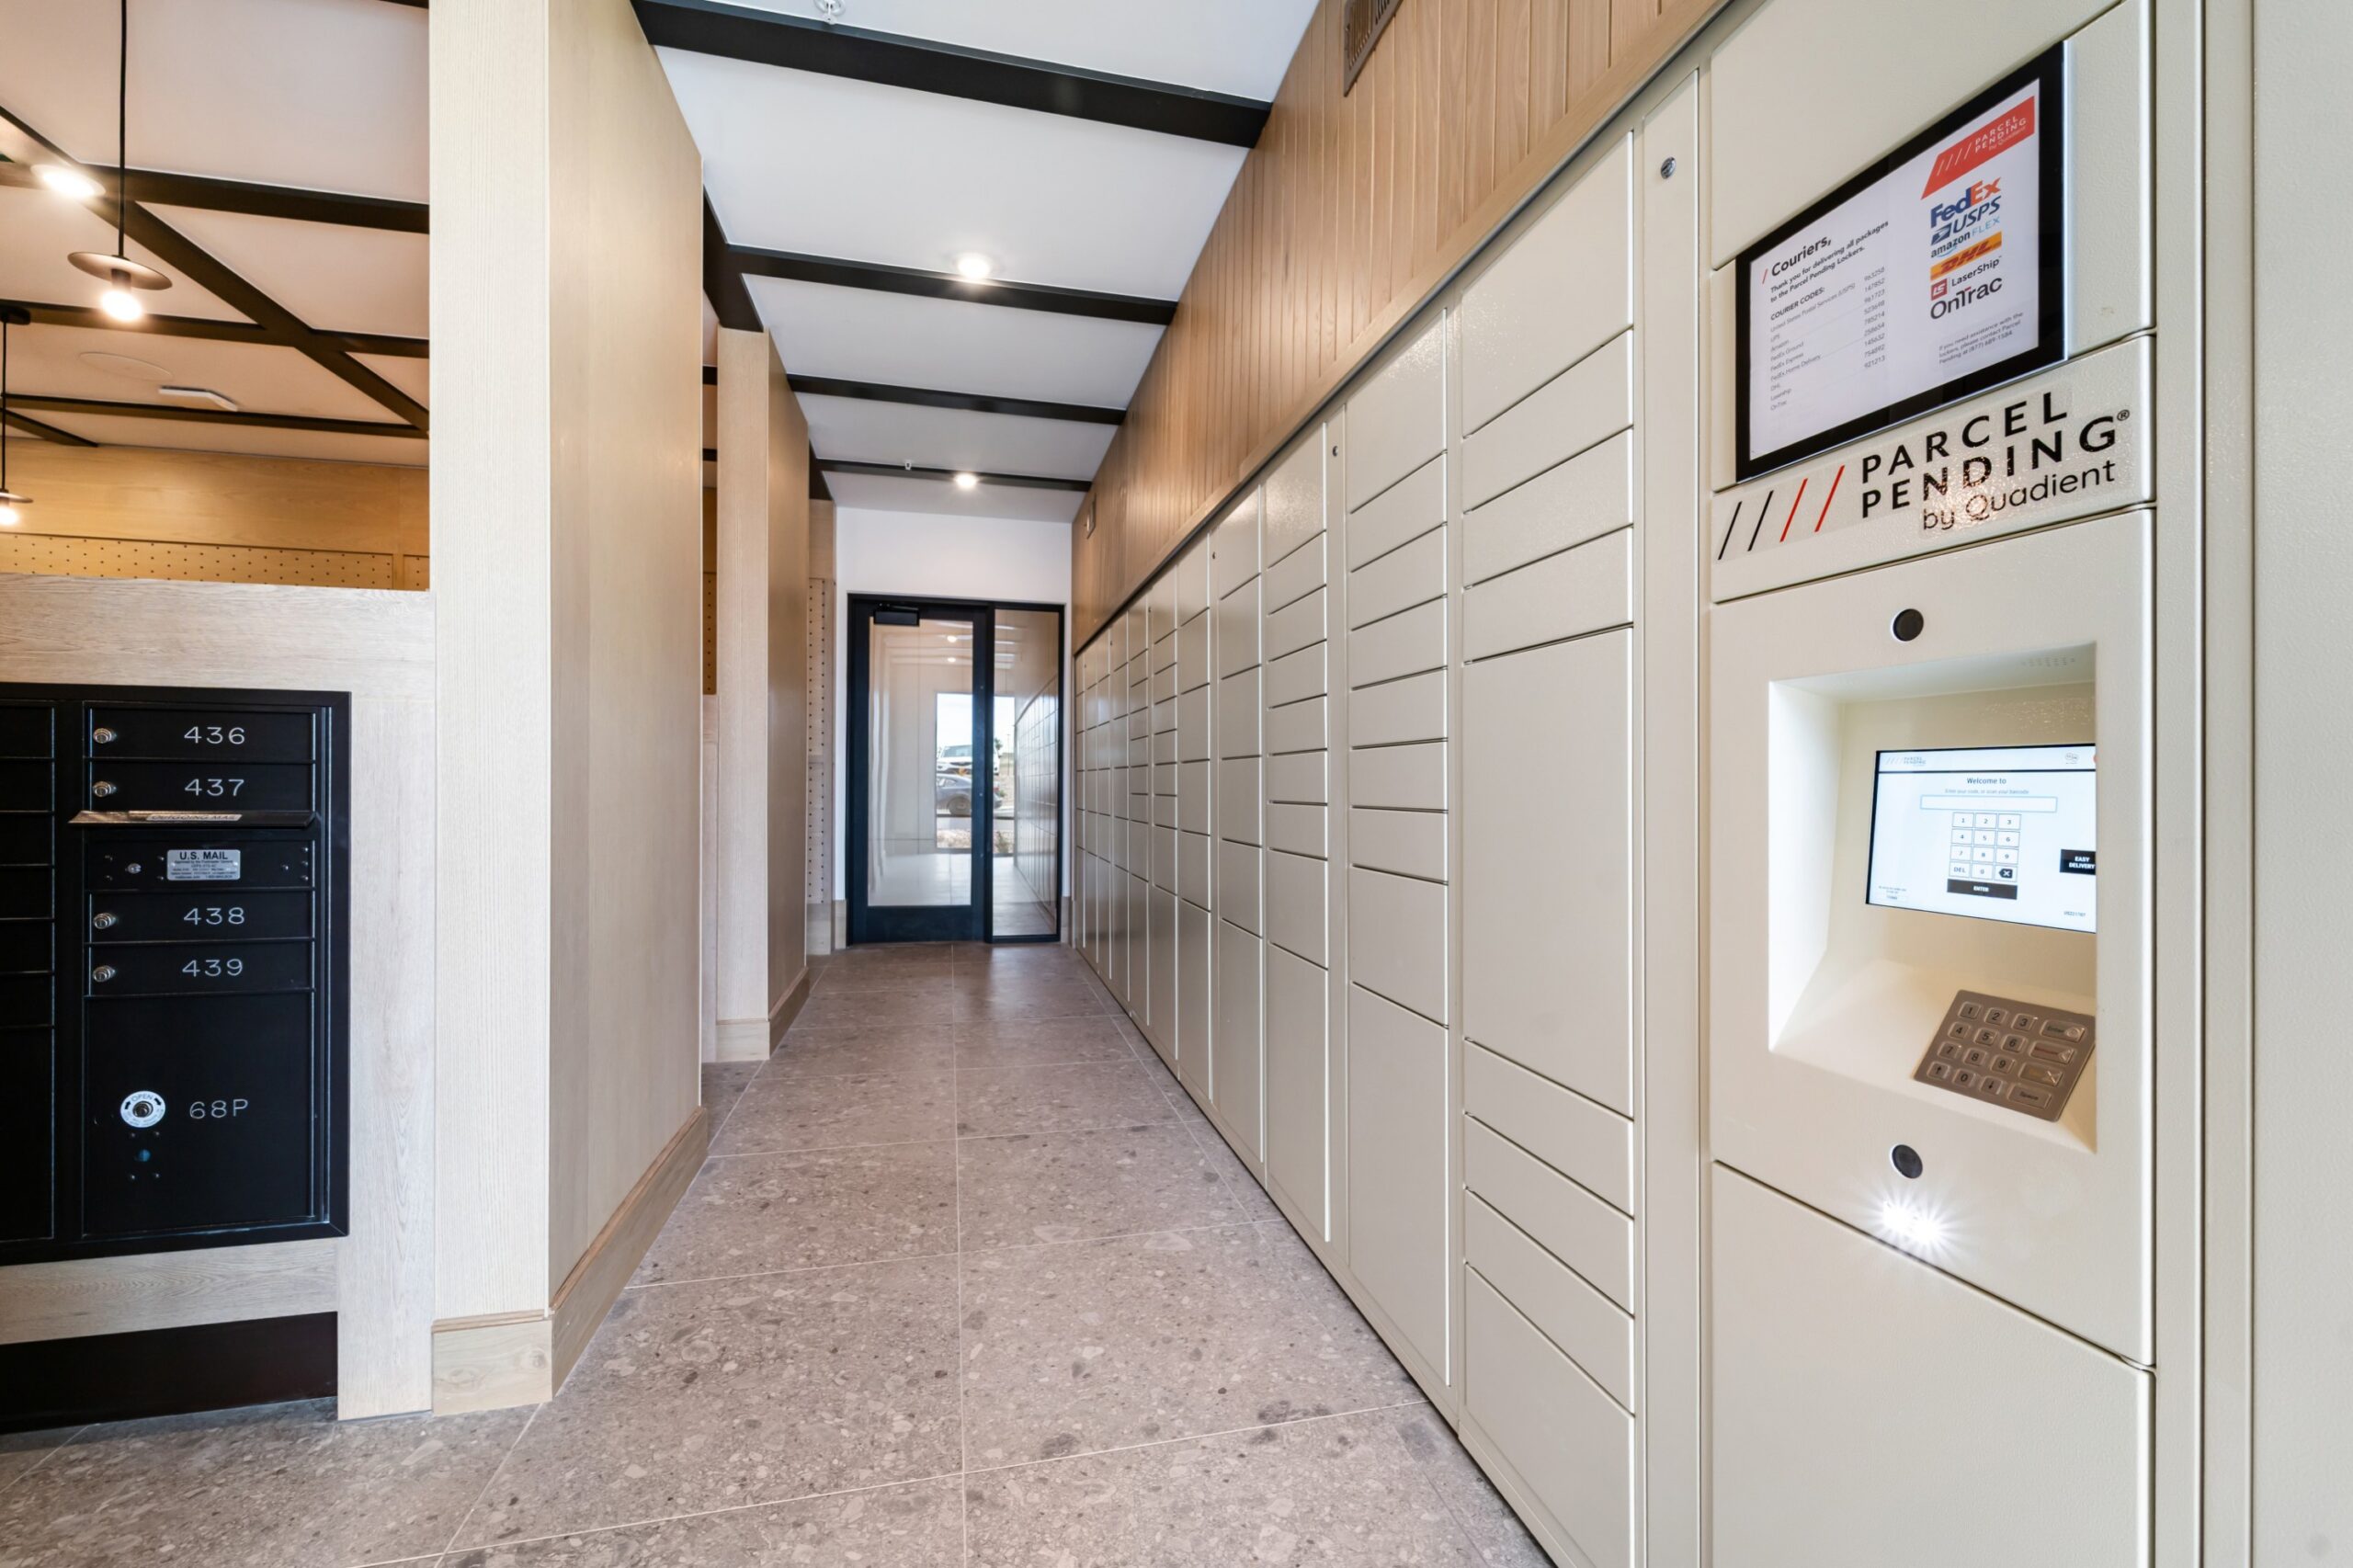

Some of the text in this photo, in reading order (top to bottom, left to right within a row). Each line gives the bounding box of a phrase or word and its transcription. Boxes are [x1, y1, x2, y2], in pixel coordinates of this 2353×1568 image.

[1975, 116, 2018, 145] PARCEL
[1975, 118, 2027, 153] PENDING
[1931, 176, 2001, 229] FedEx
[1952, 195, 2001, 233] USPS
[1931, 217, 2000, 257] amazon FLEX
[1771, 236, 1832, 277] Couriers,
[1771, 278, 1788, 292] Thank
[1790, 272, 1801, 283] you
[1802, 267, 1811, 276] for
[1813, 247, 1845, 269] delivering
[1856, 222, 1889, 245] packages
[1939, 240, 1992, 274] DHL
[1770, 246, 1865, 303] to the Parcel Pending Lockers.
[1770, 287, 1824, 321] COURIER CODES:
[1930, 278, 2002, 320] OnTrac
[1862, 392, 2067, 483] PARCEL
[1923, 460, 2116, 530] by Quadient
[184, 726, 245, 744] 436
[184, 778, 244, 797] 437
[1967, 777, 1996, 785] Welcome
[179, 851, 228, 860] U.S. MAIL
[183, 907, 245, 926] 438
[182, 959, 244, 977] 439
[1992, 1012, 2000, 1021] 2
[2019, 1017, 2028, 1027] 3
[1956, 1027, 2017, 1048] 4 5 6
[1947, 1046, 2006, 1068] 7 8 9
[1961, 1074, 1968, 1082] 0
[131, 1093, 153, 1102] OPEN
[188, 1098, 249, 1119] 68P
